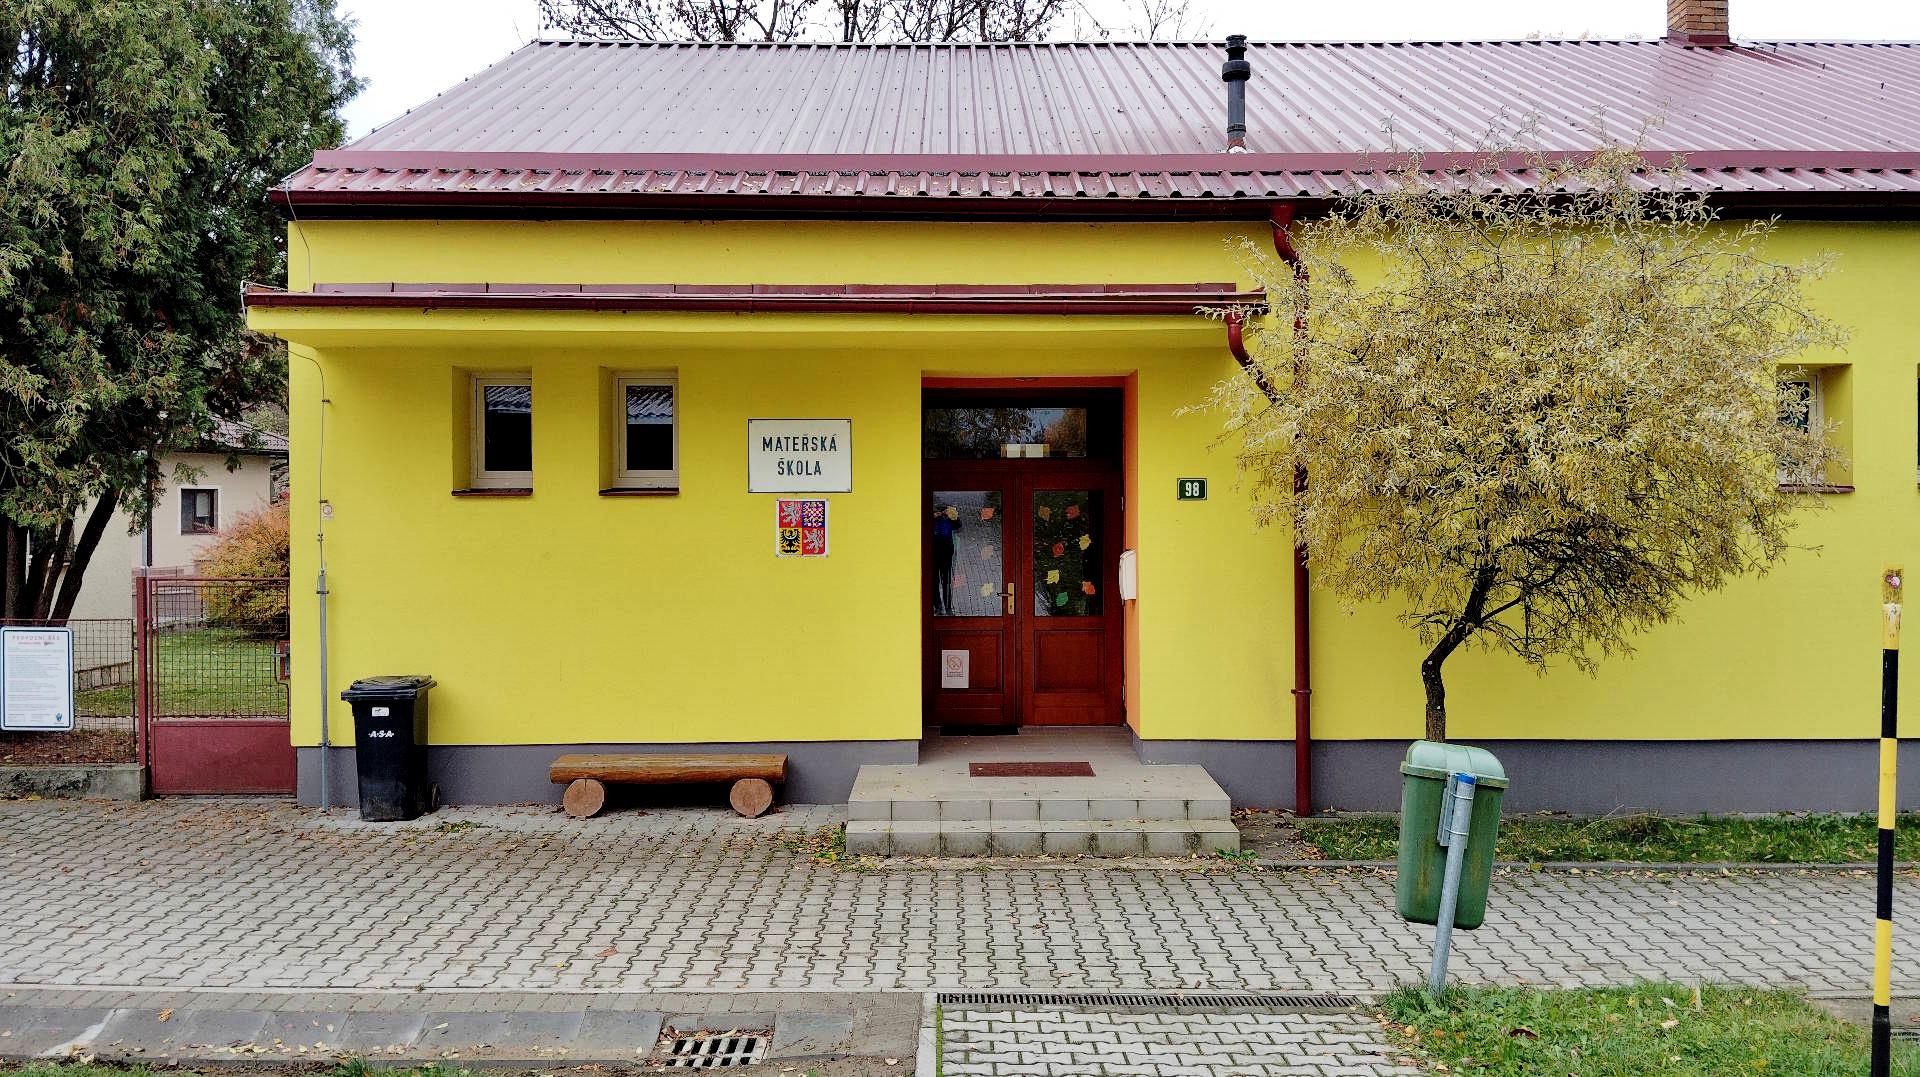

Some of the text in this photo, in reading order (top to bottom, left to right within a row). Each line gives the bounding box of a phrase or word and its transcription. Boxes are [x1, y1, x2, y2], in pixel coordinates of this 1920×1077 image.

[762, 433, 838, 451] MATEŘSKÁ
[777, 457, 822, 476] ŠKOLA
[1185, 482, 1200, 497] 98
